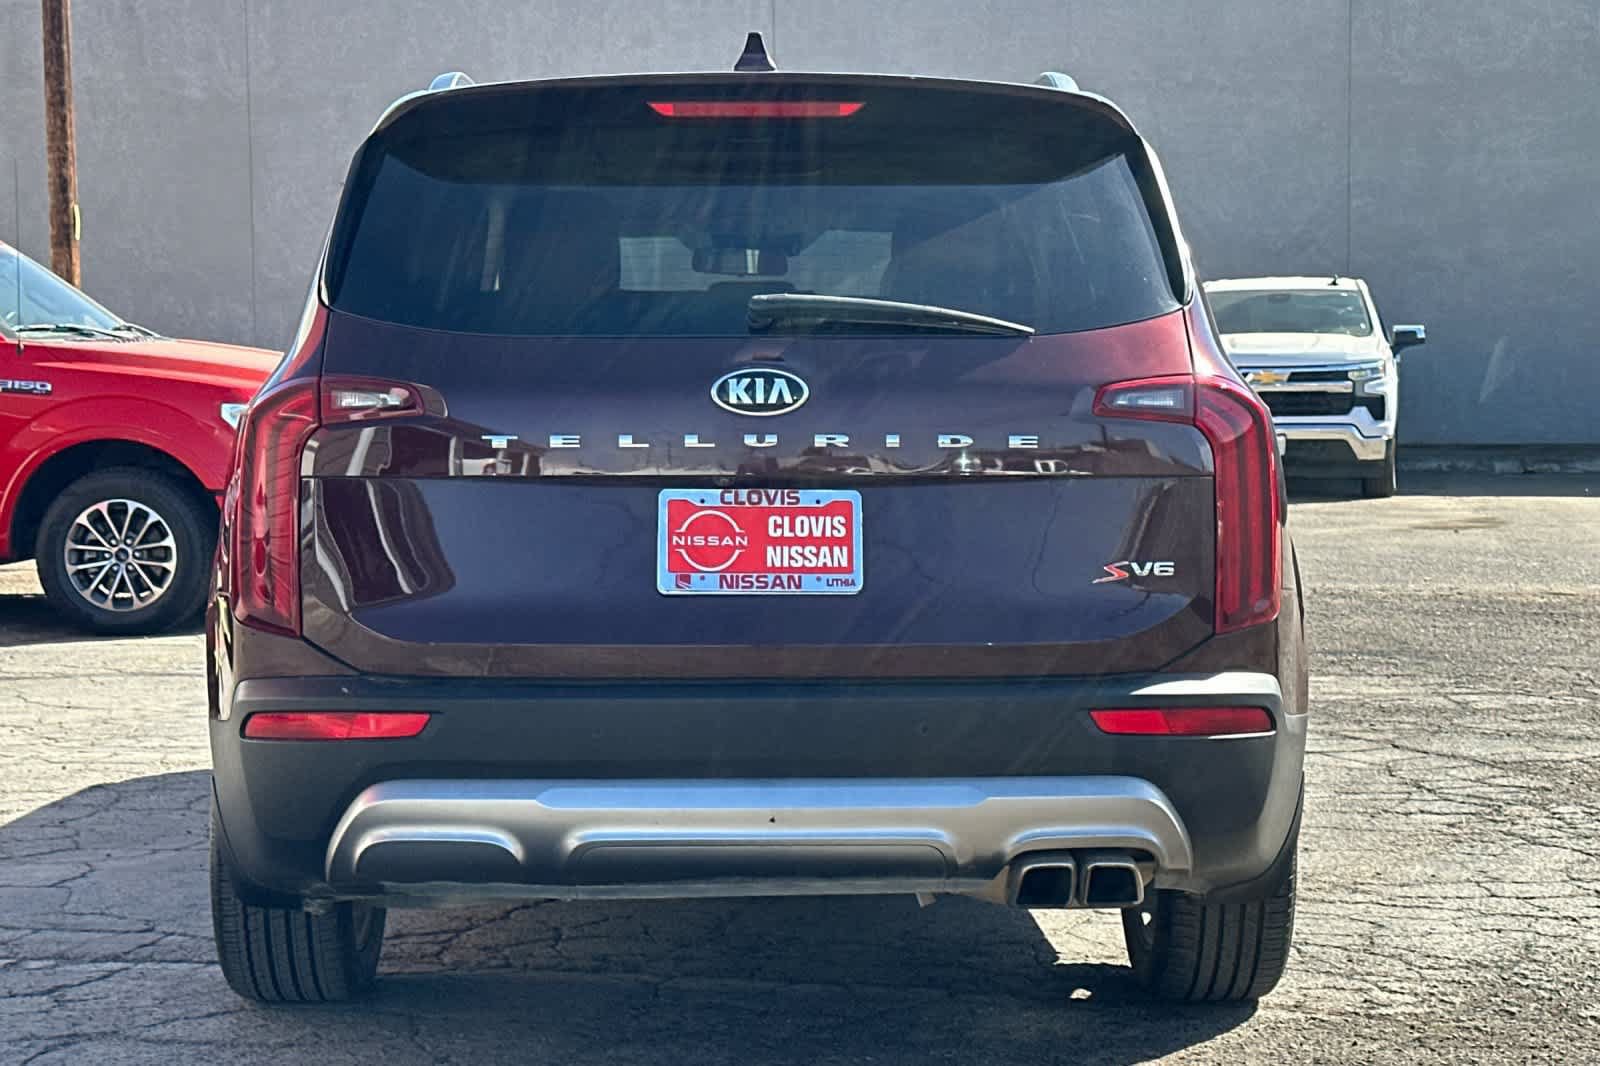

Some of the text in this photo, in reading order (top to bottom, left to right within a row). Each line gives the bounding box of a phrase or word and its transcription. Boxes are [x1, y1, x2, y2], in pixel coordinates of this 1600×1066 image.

[727, 377, 793, 404] KIA
[481, 434, 1039, 449] TELLURIDE
[719, 489, 801, 506] CLOVIS
[768, 515, 847, 538] CLOVIS
[672, 535, 749, 547] NISSAN
[766, 545, 849, 568] NISSAN
[719, 574, 802, 590] NISSAN
